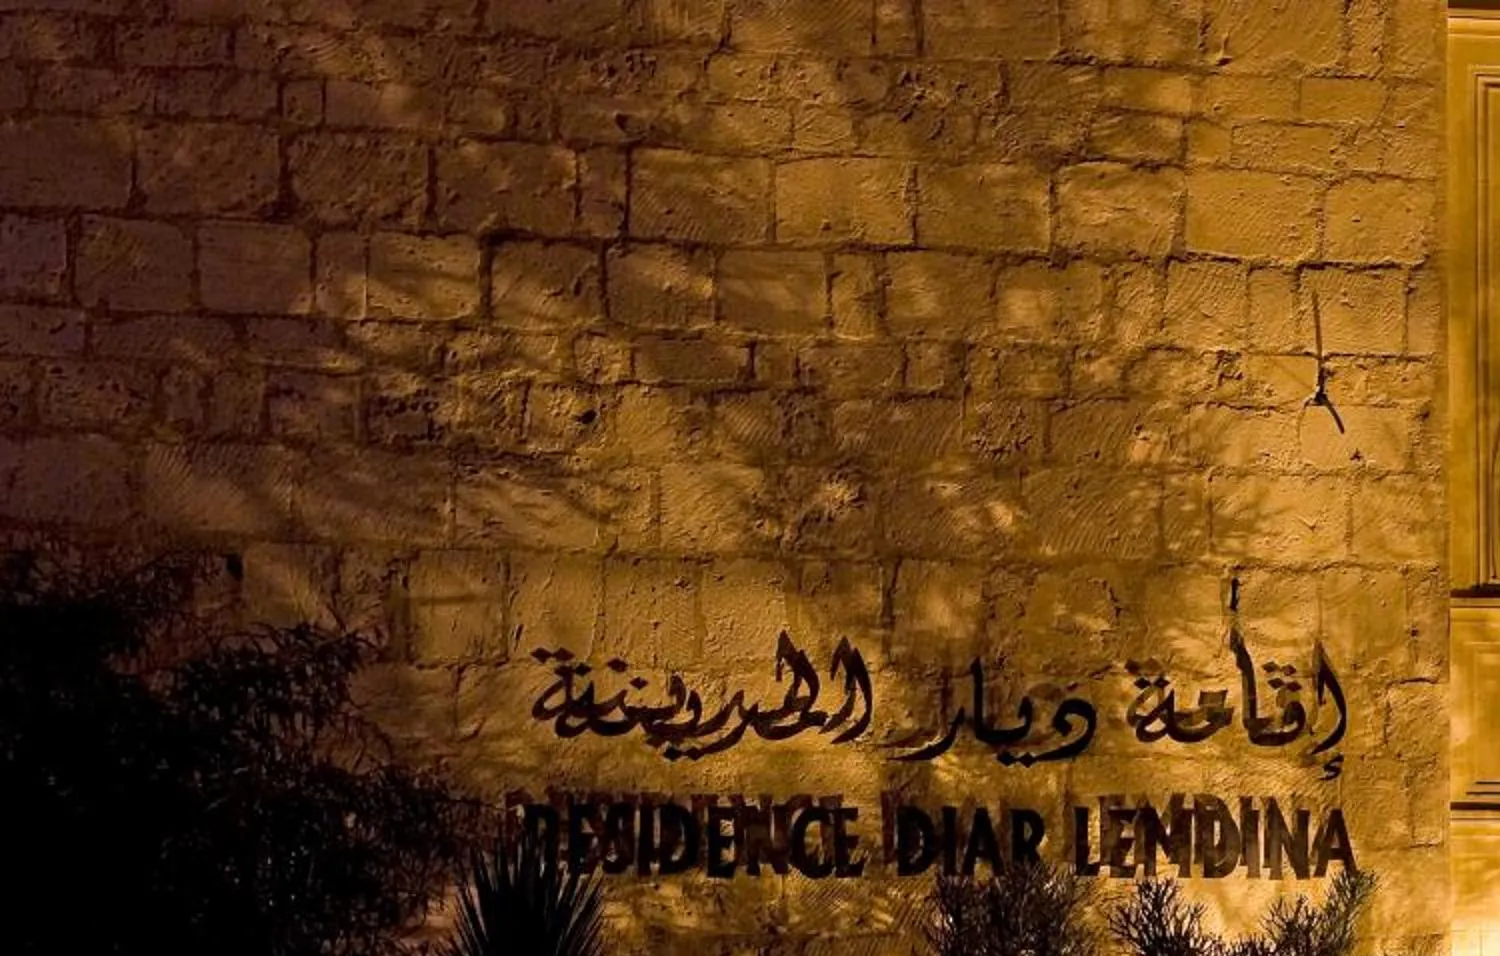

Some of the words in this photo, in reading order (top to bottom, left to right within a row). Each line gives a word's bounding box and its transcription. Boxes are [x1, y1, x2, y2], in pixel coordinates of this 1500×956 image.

[531, 629, 873, 762] المدينة
[887, 656, 1096, 768] ديار
[522, 801, 862, 878] RESIDENCE
[896, 806, 1046, 877] DIAR
[1073, 804, 1358, 880] LEMDINA
